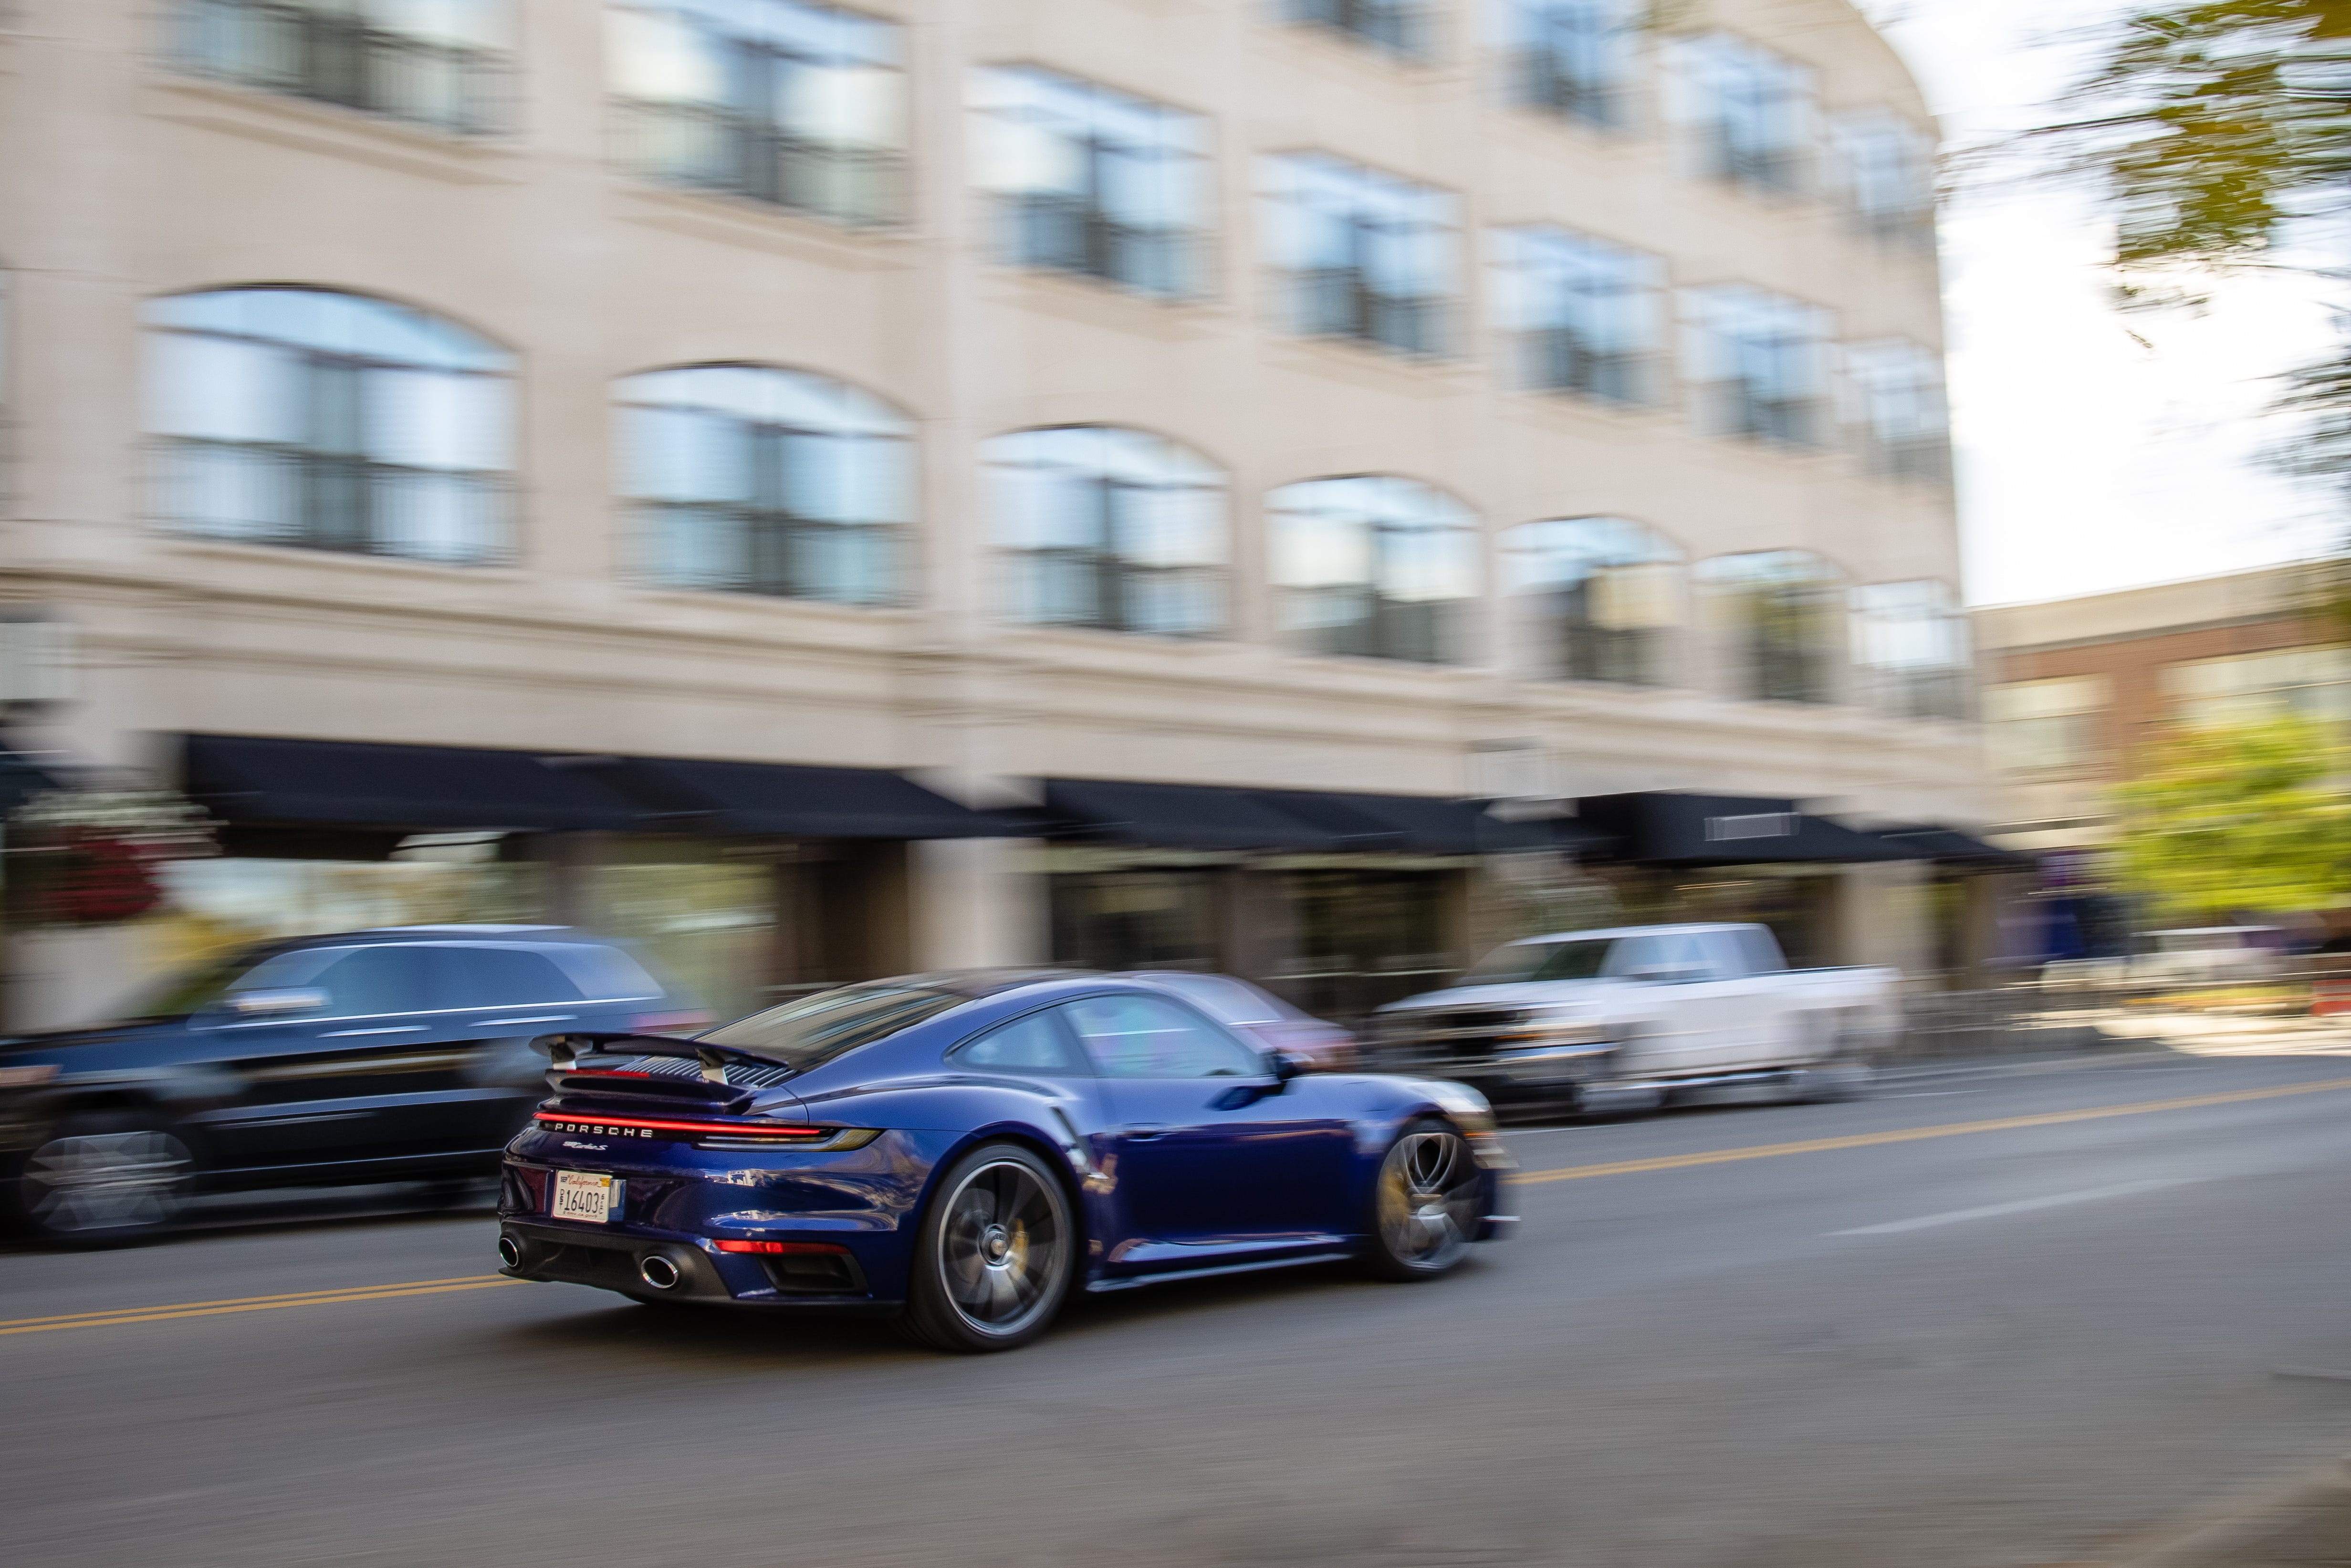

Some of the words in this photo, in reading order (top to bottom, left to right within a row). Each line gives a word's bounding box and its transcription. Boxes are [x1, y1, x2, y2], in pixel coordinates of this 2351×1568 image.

[555, 1123, 653, 1138] PORSCHE
[568, 1175, 598, 1189] California
[564, 1190, 599, 1213] 16403
